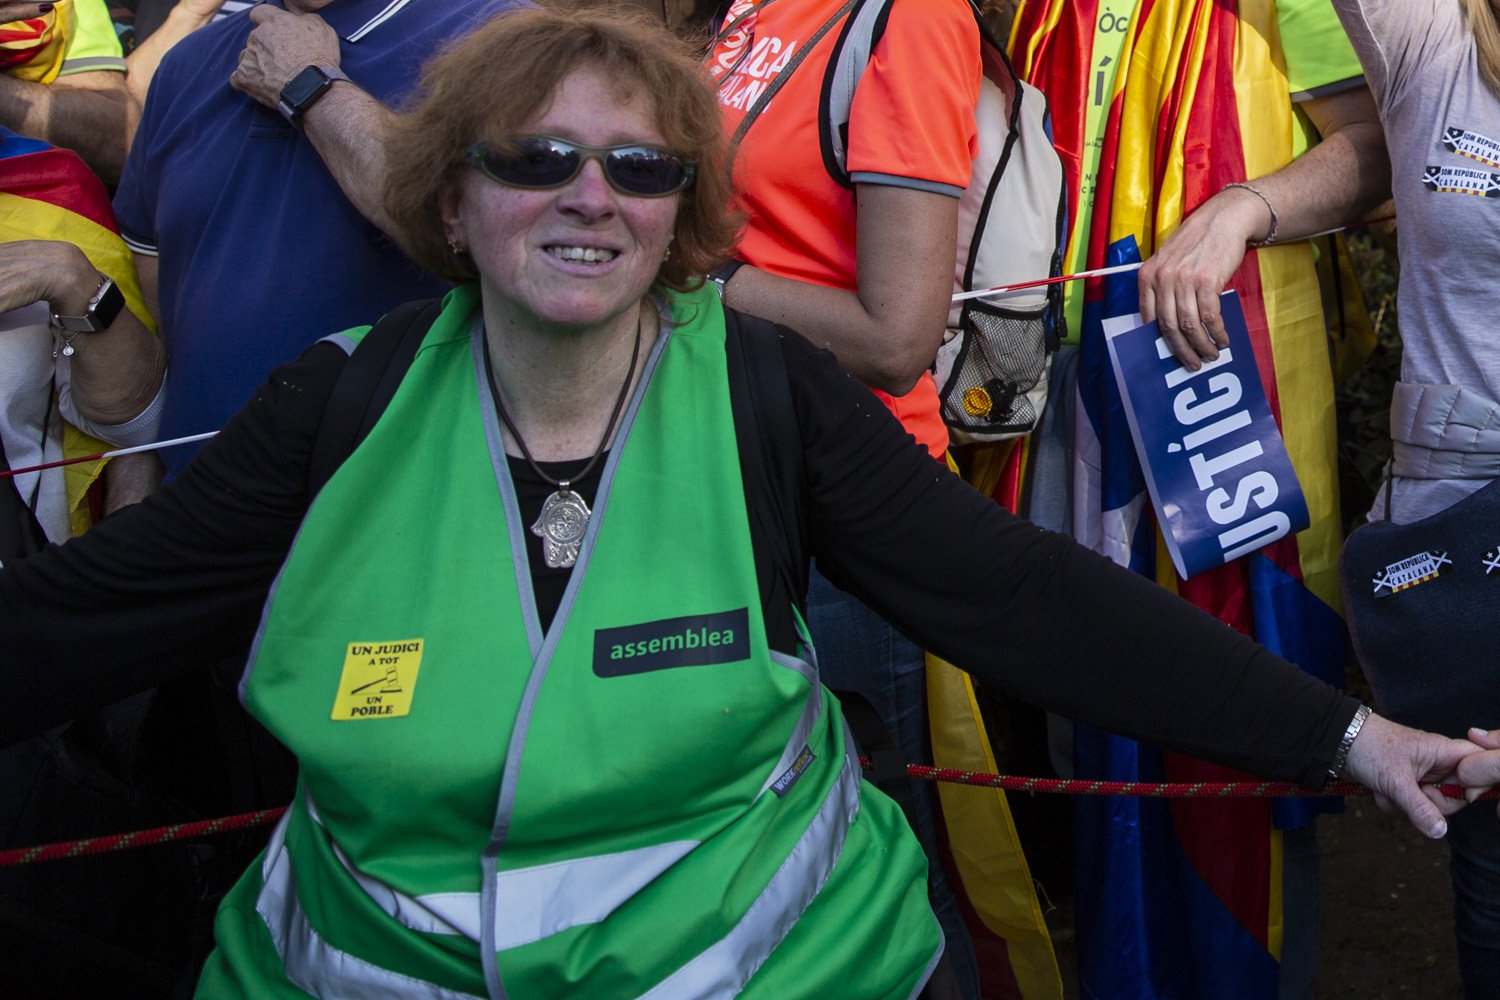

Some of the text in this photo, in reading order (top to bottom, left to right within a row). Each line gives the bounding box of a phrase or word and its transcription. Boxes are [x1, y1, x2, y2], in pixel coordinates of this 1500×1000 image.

[1463, 133, 1477, 142] SOM
[1440, 168, 1453, 176] SOM
[1439, 179, 1486, 190] CATALANA
[1155, 335, 1291, 563] USTÍCI
[1387, 553, 1430, 576] SOM REPÚBLICA
[1391, 563, 1435, 587] CATALANA
[351, 643, 420, 656] UN JUDICI
[610, 627, 734, 660] assemblea
[368, 657, 400, 666] A TOT
[366, 696, 383, 705] UN
[350, 705, 394, 717] POBLE
